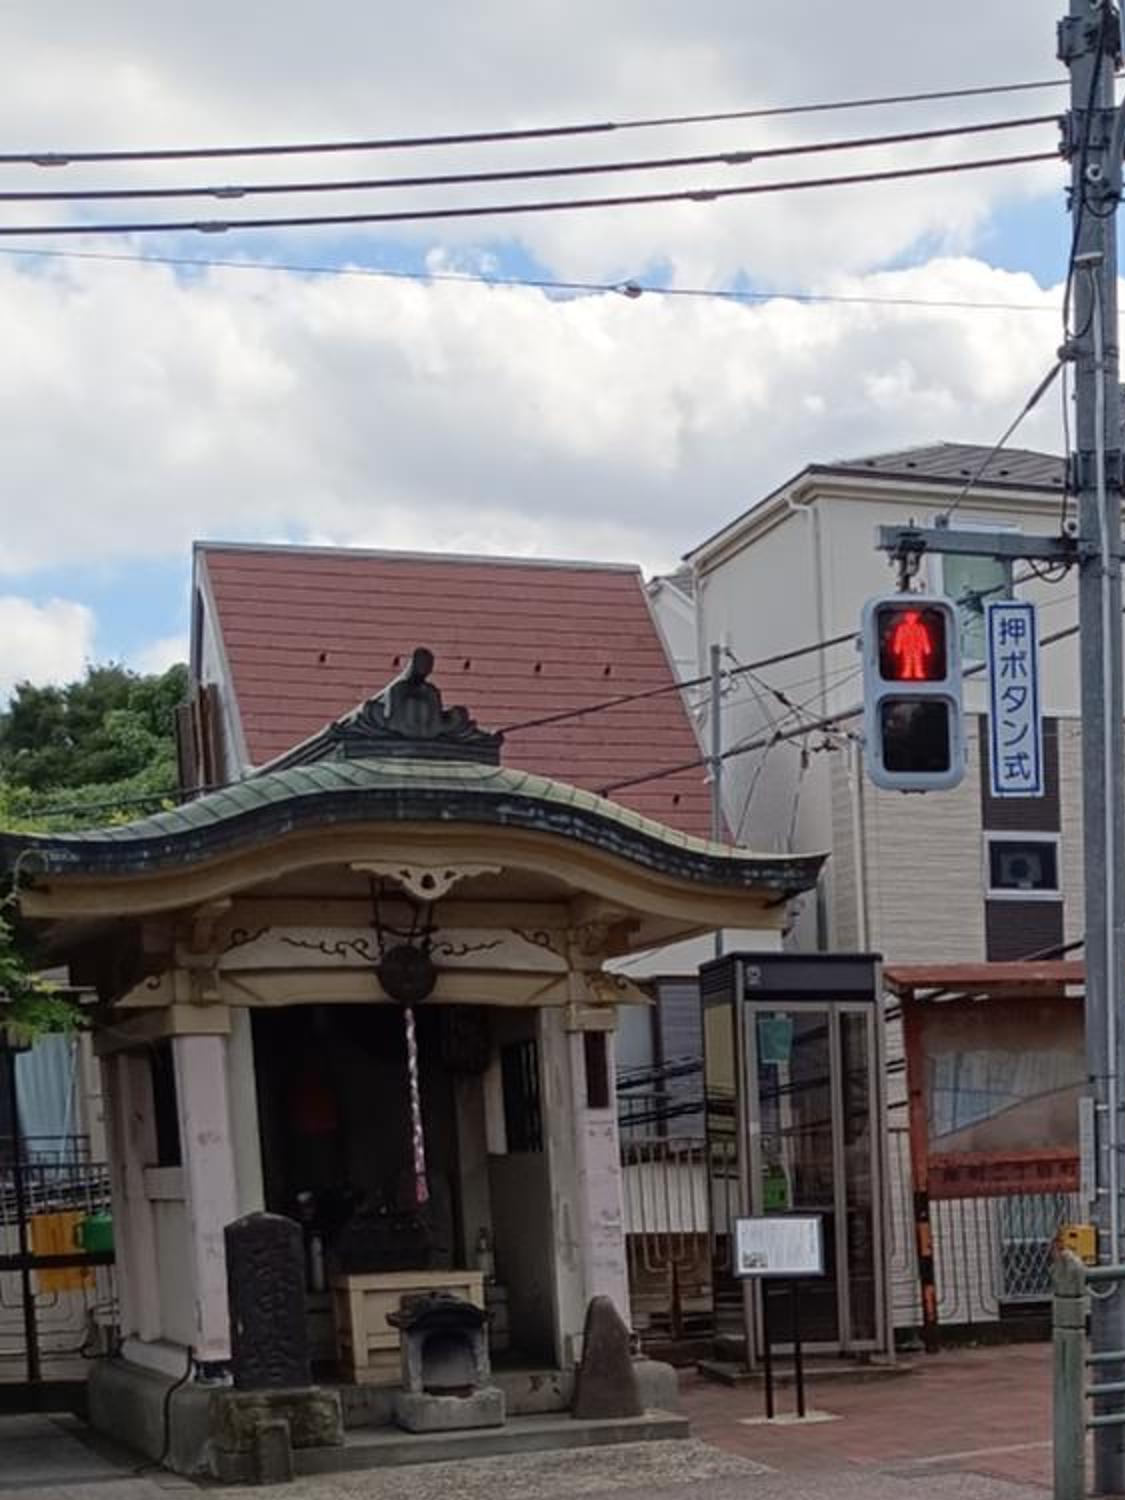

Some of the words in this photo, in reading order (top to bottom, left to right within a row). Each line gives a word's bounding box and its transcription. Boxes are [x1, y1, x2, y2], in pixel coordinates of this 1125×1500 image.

[998, 618, 1031, 782] 押ボタン式
